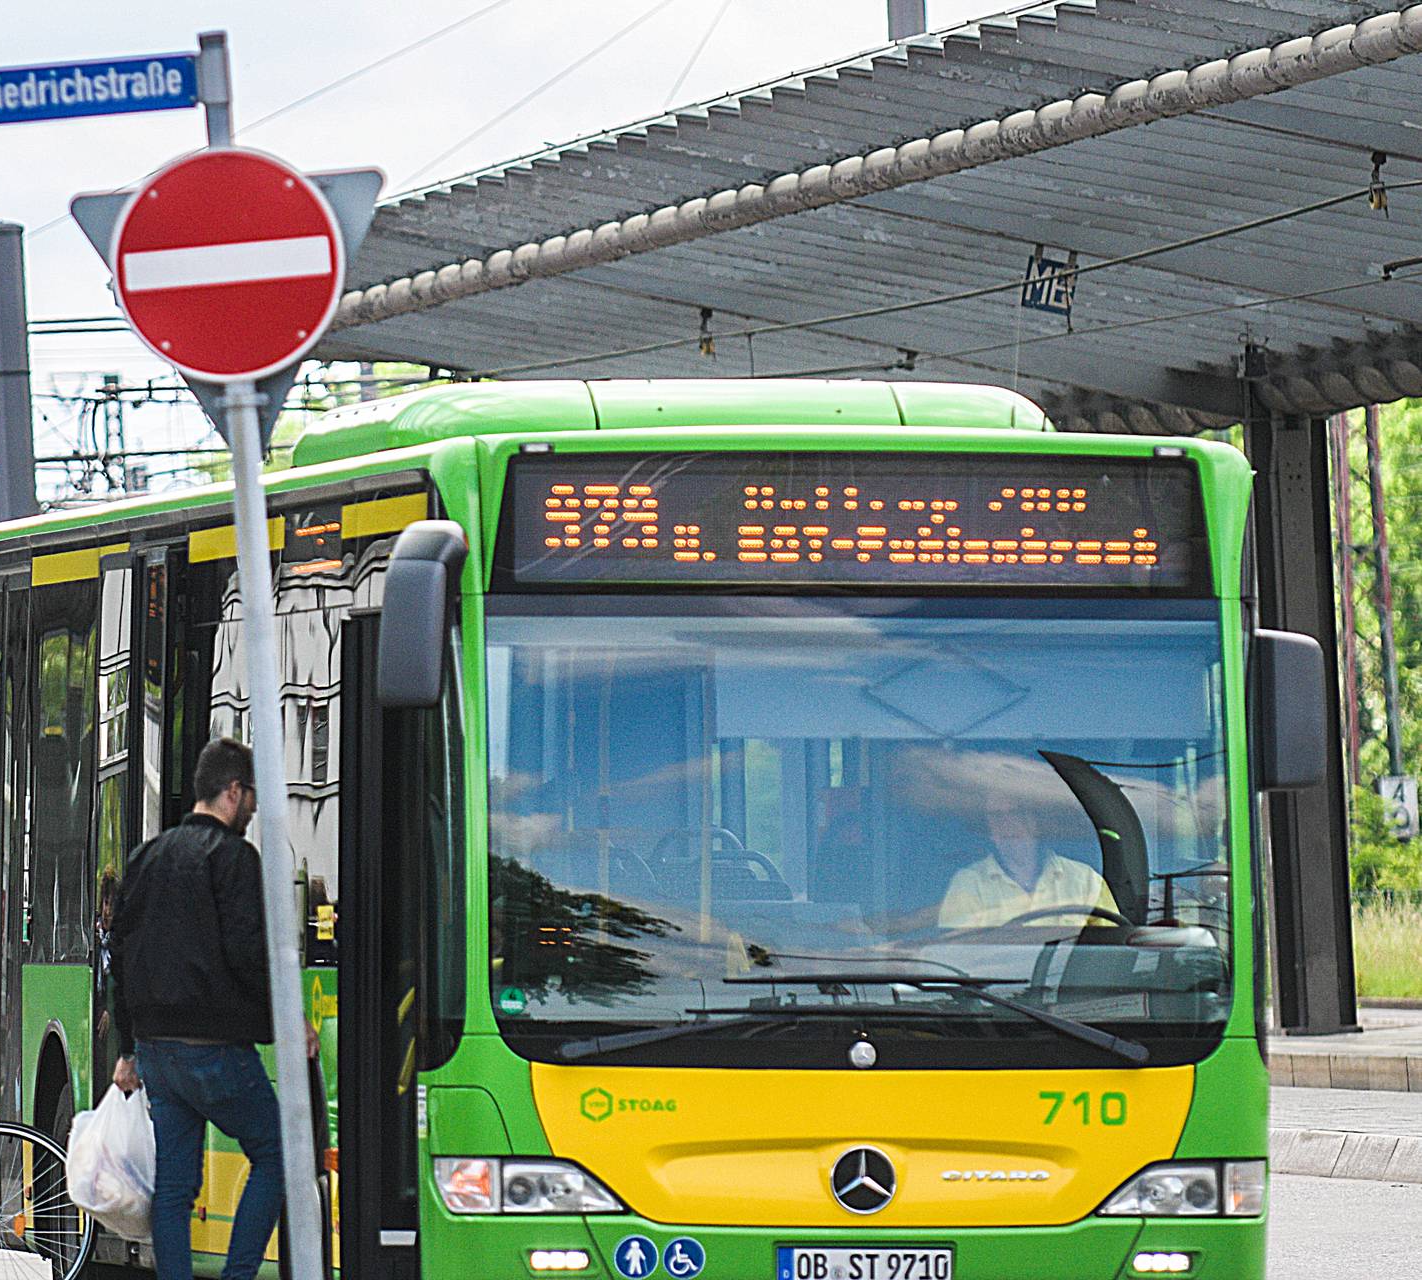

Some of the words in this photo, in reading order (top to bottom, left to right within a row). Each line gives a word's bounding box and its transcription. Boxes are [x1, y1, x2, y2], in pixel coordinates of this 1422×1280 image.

[618, 1098, 677, 1112] STOAG
[1039, 1091, 1128, 1125] 710
[941, 1170, 1051, 1181] CITARO
[797, 1253, 828, 1280] OB
[849, 1253, 880, 1280] ST
[887, 1253, 949, 1280] 9710
